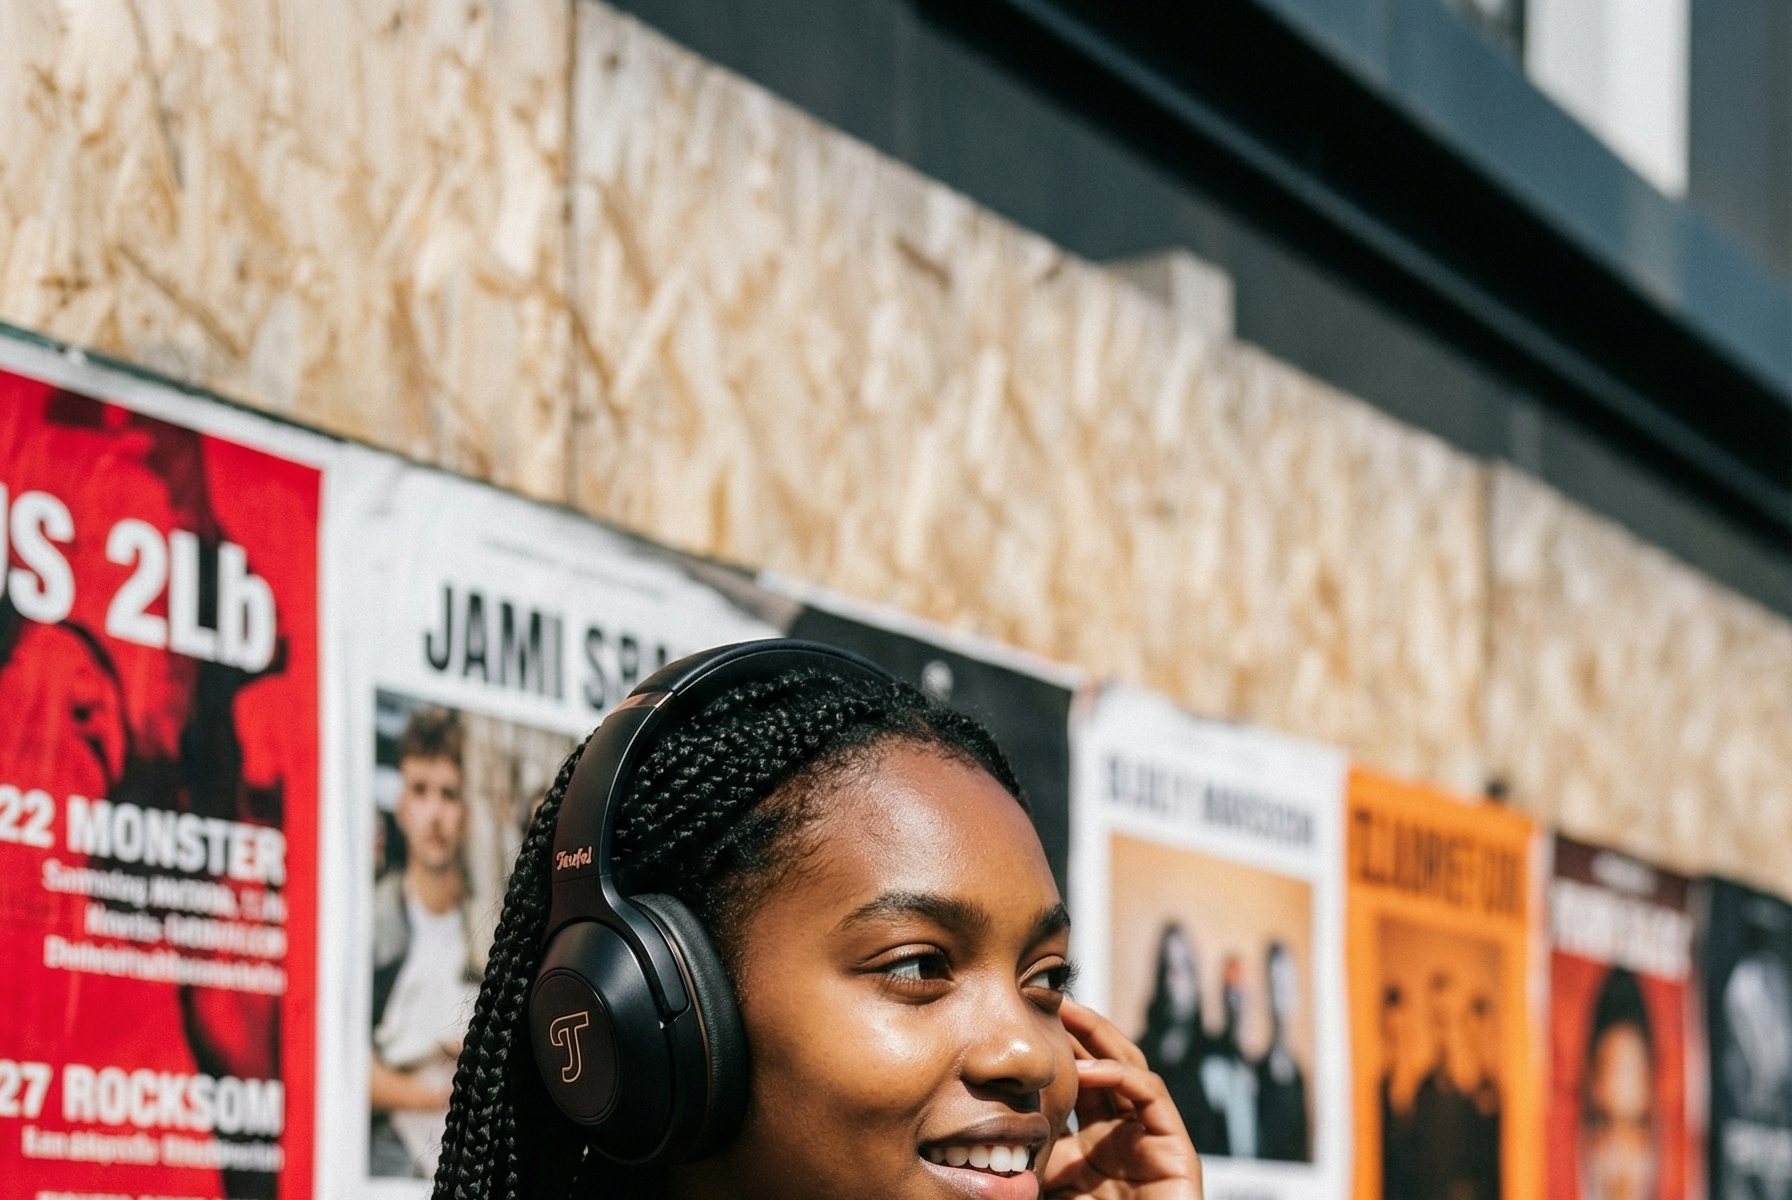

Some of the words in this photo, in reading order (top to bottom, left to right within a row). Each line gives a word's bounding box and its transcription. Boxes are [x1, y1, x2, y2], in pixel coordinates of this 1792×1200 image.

[0, 481, 75, 623] S
[105, 517, 276, 672] 2Lb
[424, 581, 564, 700] JAMI
[0, 785, 54, 848] 22
[67, 795, 285, 885] MONSTER
[556, 846, 592, 870] Teufel
[63, 1064, 285, 1137] ROCKSOM
